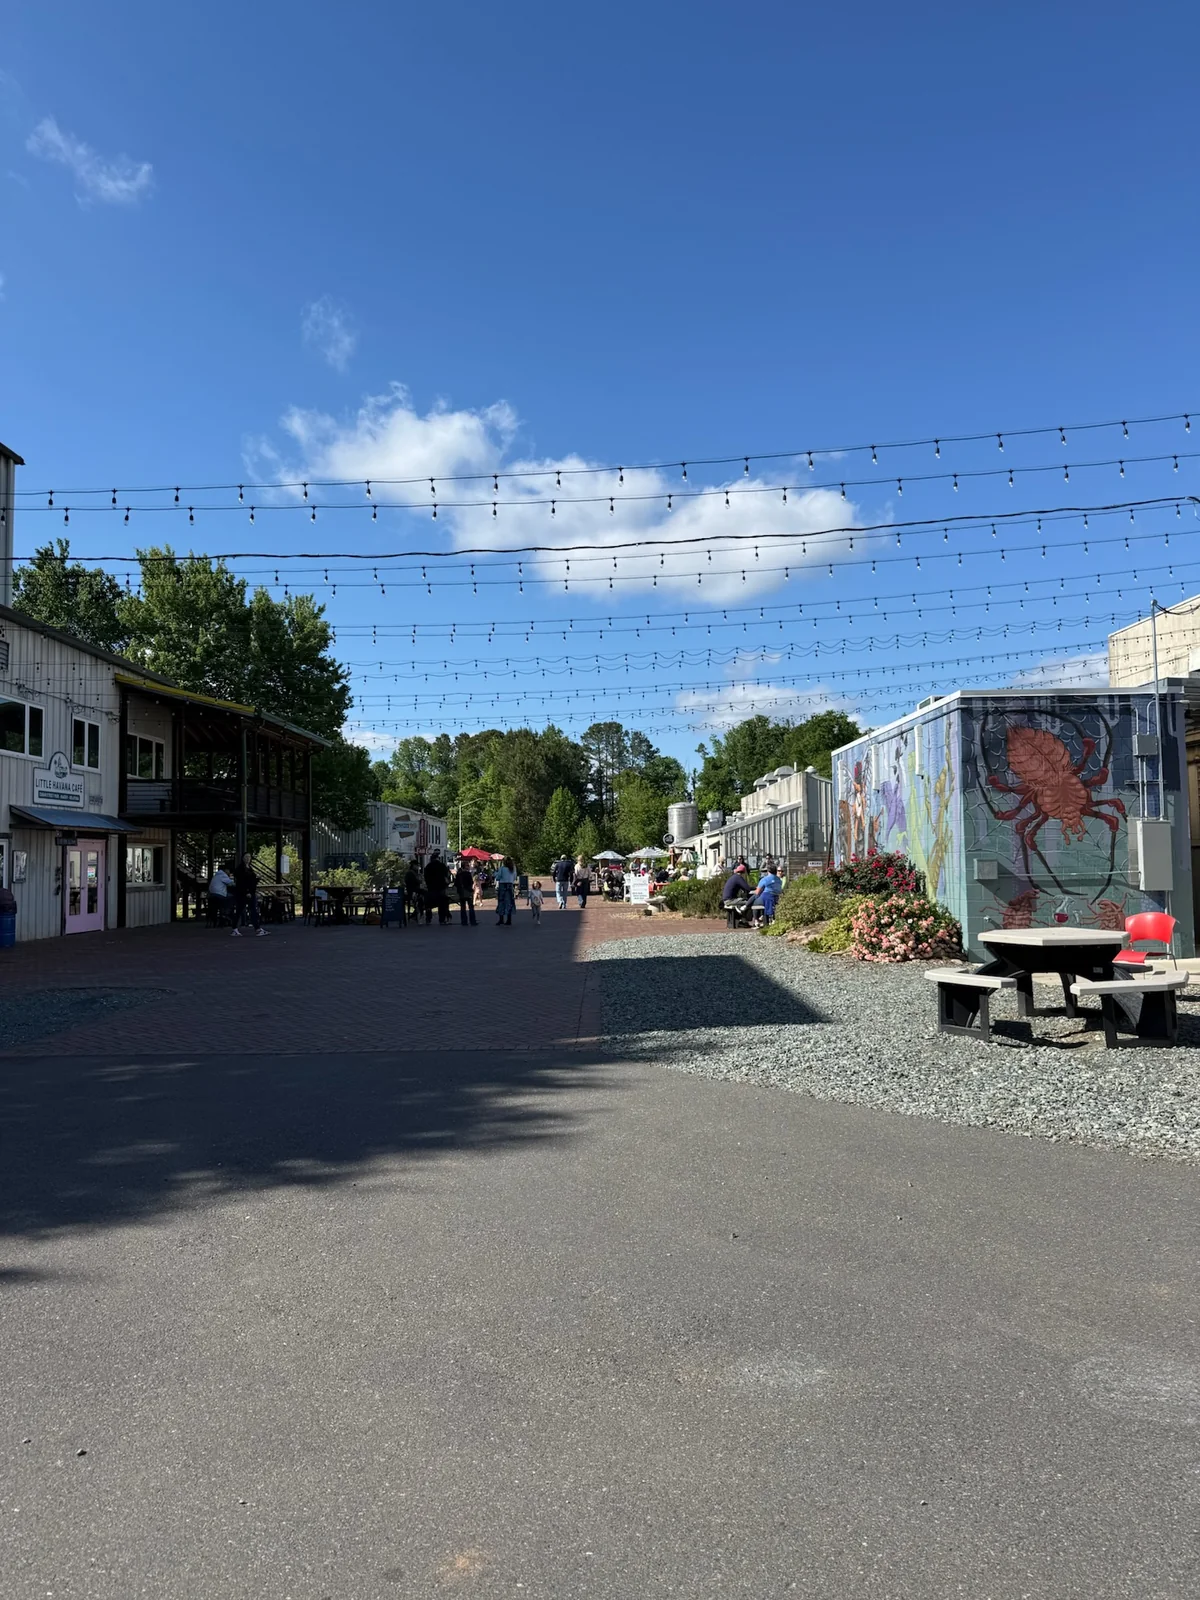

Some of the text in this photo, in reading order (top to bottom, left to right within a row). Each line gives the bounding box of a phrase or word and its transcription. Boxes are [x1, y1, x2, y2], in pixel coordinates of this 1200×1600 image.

[36, 778, 83, 793] LITTLE HAVANA CAFÉ
